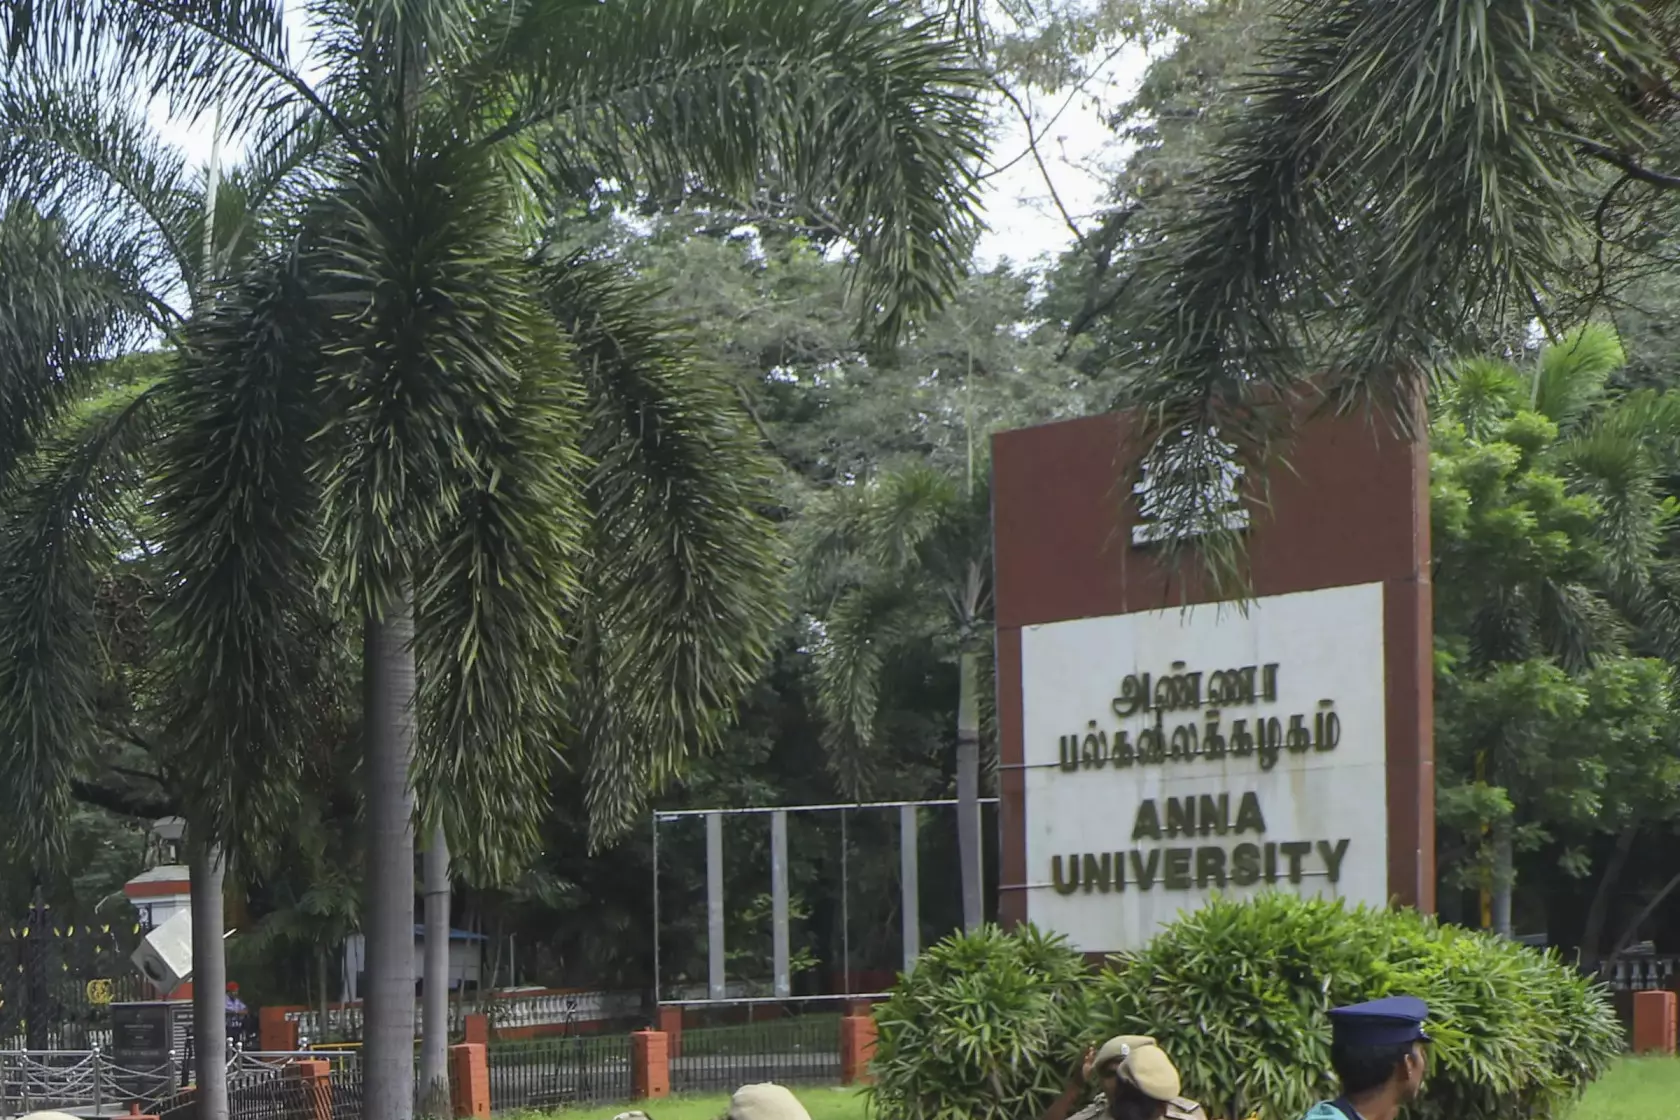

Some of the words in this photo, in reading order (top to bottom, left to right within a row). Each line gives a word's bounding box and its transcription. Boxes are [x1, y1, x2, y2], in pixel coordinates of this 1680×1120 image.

[1112, 661, 1280, 718] அண்ணா
[1059, 699, 1341, 772] பல்கலைக்கழகம்
[1131, 791, 1266, 840] ANNA
[1052, 838, 1351, 896] UNIVERSITY
